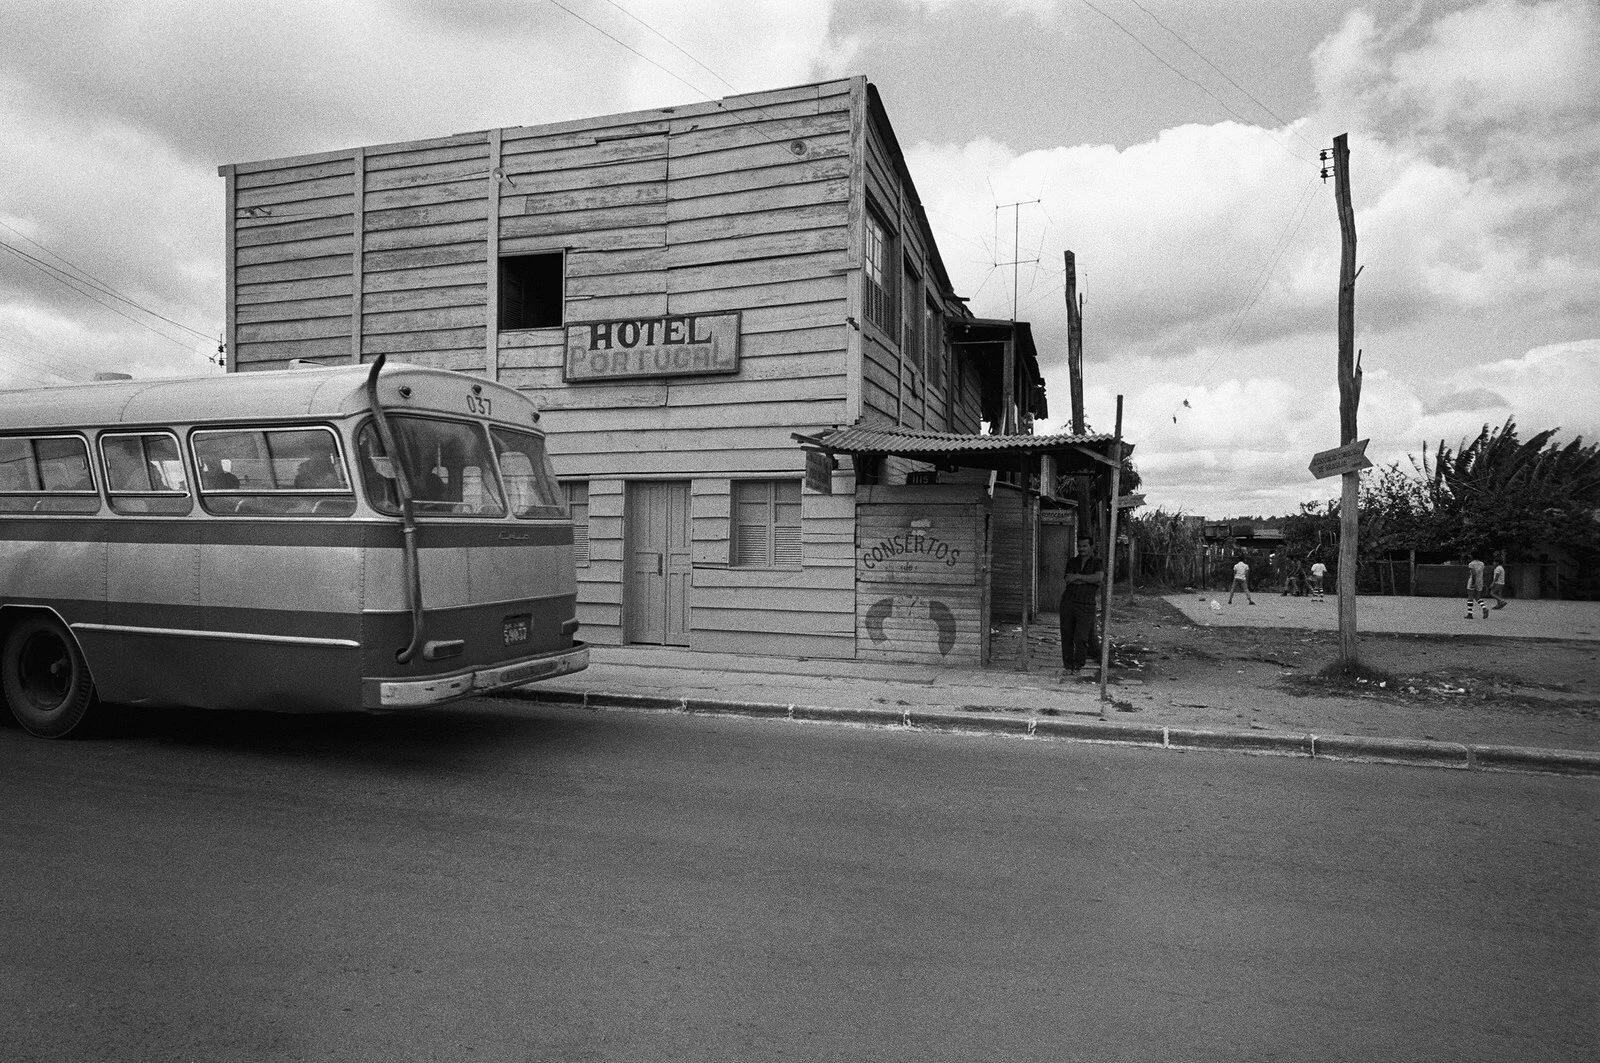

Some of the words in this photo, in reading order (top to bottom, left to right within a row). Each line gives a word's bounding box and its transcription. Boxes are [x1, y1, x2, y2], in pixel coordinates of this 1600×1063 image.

[588, 317, 713, 350] HOTEL
[466, 395, 491, 415] 037
[863, 533, 960, 569] CONSERTOS
